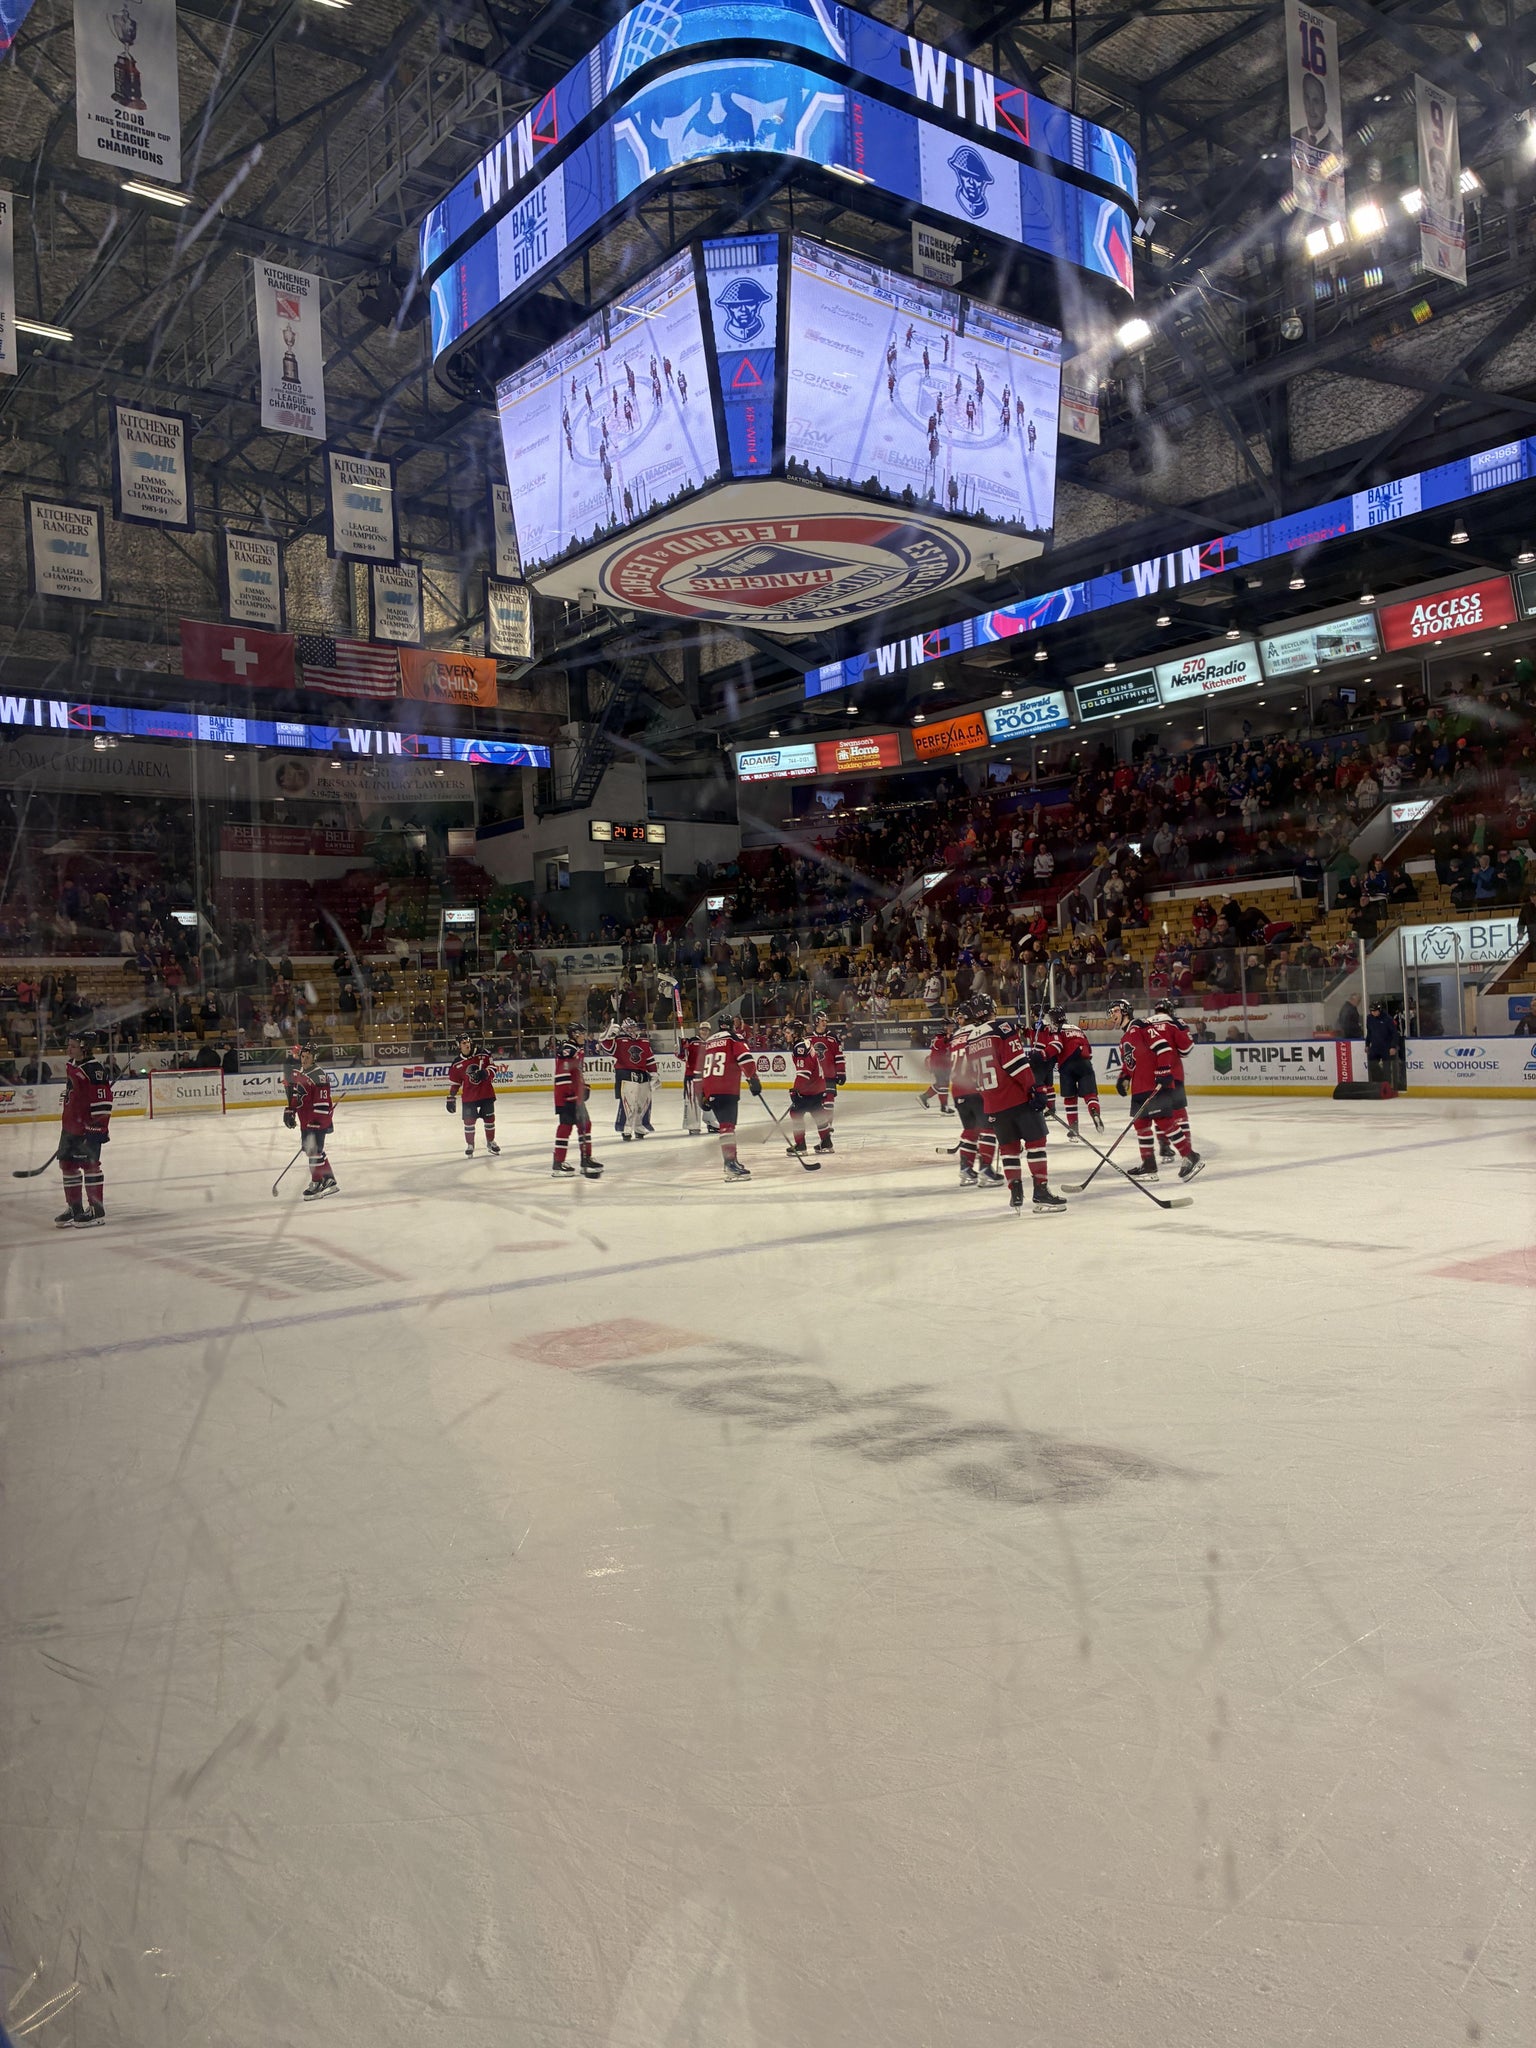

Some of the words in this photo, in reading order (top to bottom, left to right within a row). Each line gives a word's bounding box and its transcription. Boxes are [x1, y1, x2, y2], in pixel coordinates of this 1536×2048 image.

[1299, 20, 1327, 77] 16
[908, 36, 996, 132] WIN
[114, 109, 145, 126] 2008
[1430, 101, 1445, 148] 9
[111, 128, 150, 149] LEAGUE
[157, 132, 171, 142] CUP
[97, 137, 164, 166] CHAMPIONS
[477, 111, 534, 213] WIN
[512, 184, 547, 240] BATTLE
[514, 229, 548, 281] BUILT
[918, 244, 957, 268] RANGERS
[263, 267, 311, 288] KITCHENER
[268, 278, 308, 297] RANGERS
[269, 398, 317, 416] CHAMPIONS
[277, 393, 307, 406] LEAGUE
[120, 413, 181, 437] KITCHENER
[746, 406, 757, 452] KR-WIN
[127, 428, 176, 449] RANGERS
[1478, 445, 1517, 465] KR-1963
[334, 459, 386, 480] KITCHENER
[134, 482, 174, 496] DIVISION
[141, 475, 167, 486] EMMS
[787, 475, 823, 488] DAKTRONICS
[127, 489, 182, 506] CHAMPIONS
[1368, 480, 1403, 504] BATTLE
[37, 507, 93, 526] KITCHENER
[1368, 502, 1403, 525] BUILT
[43, 520, 89, 536] RANGERS
[341, 528, 388, 543] CHAMPIONS
[348, 522, 379, 534] LEAGUE
[229, 539, 276, 556] KITCHENER
[663, 524, 800, 555] LEGEND
[234, 551, 272, 566] RANGERS
[719, 550, 778, 575] OHL
[43, 572, 94, 584] CHAMPIONS
[375, 566, 416, 580] KITCHENER
[620, 554, 668, 599] LEGACY
[857, 540, 949, 609] ESTABLISHED
[1132, 545, 1200, 598] WIN
[379, 574, 414, 588] RANGERS
[489, 582, 528, 596] KITCHENER
[688, 569, 834, 592] RANGERS
[234, 599, 277, 610] CHAMPIONS
[239, 593, 270, 602] DIVISION
[493, 591, 525, 604] RANGERS
[812, 605, 850, 618] IN
[1410, 592, 1481, 625] ACCESS
[379, 619, 416, 630] CHAMPIONS
[1412, 609, 1483, 638] STORAGE
[1281, 638, 1309, 650] RECYCLING
[876, 633, 925, 675] WIN
[437, 664, 476, 678] EVERY
[1171, 661, 1246, 689] NewsRadio
[1182, 658, 1206, 675] 570
[438, 675, 478, 693] CHILD
[1097, 682, 1134, 697] ROBINS
[1202, 674, 1247, 691] Kitchener
[440, 690, 479, 702] MATTERS
[1081, 687, 1155, 710] GOLDSMITHING
[0, 695, 69, 729] WIN
[996, 706, 1018, 718] Terry
[1020, 696, 1052, 712] Howald
[209, 716, 235, 728] BATTLE
[994, 704, 1061, 732] POOLS
[209, 731, 235, 743] BUILT
[348, 727, 402, 755] WIN
[839, 738, 874, 748] Swanson's
[915, 722, 984, 750] PERFEXIA.CA
[850, 745, 879, 756] Home
[8, 750, 46, 769] DOM
[127, 759, 171, 778] ARENA
[743, 755, 777, 766] ADAMS
[838, 761, 863, 770] building
[791, 768, 816, 776] INTERLOCK
[317, 777, 372, 789] PERSONAL
[415, 779, 465, 790] LAWYERS
[234, 826, 262, 838] BELL
[325, 832, 354, 843] BELL
[614, 826, 627, 838] 24
[632, 827, 645, 839] 23
[1470, 950, 1520, 961] CANAD
[1008, 1039, 1022, 1053] 25
[1236, 1047, 1304, 1063] TRIPLE
[1308, 1046, 1325, 1062] M
[703, 1052, 726, 1077] 93
[867, 1053, 903, 1073] NEXT
[1239, 1065, 1325, 1073] METAL
[1434, 1061, 1499, 1070] WOODHOUSE
[342, 1071, 386, 1086] MAPEI
[97, 1088, 106, 1099] 51
[176, 1087, 200, 1099] Sun
[204, 1085, 227, 1098] Life
[320, 1090, 328, 1099] 13
